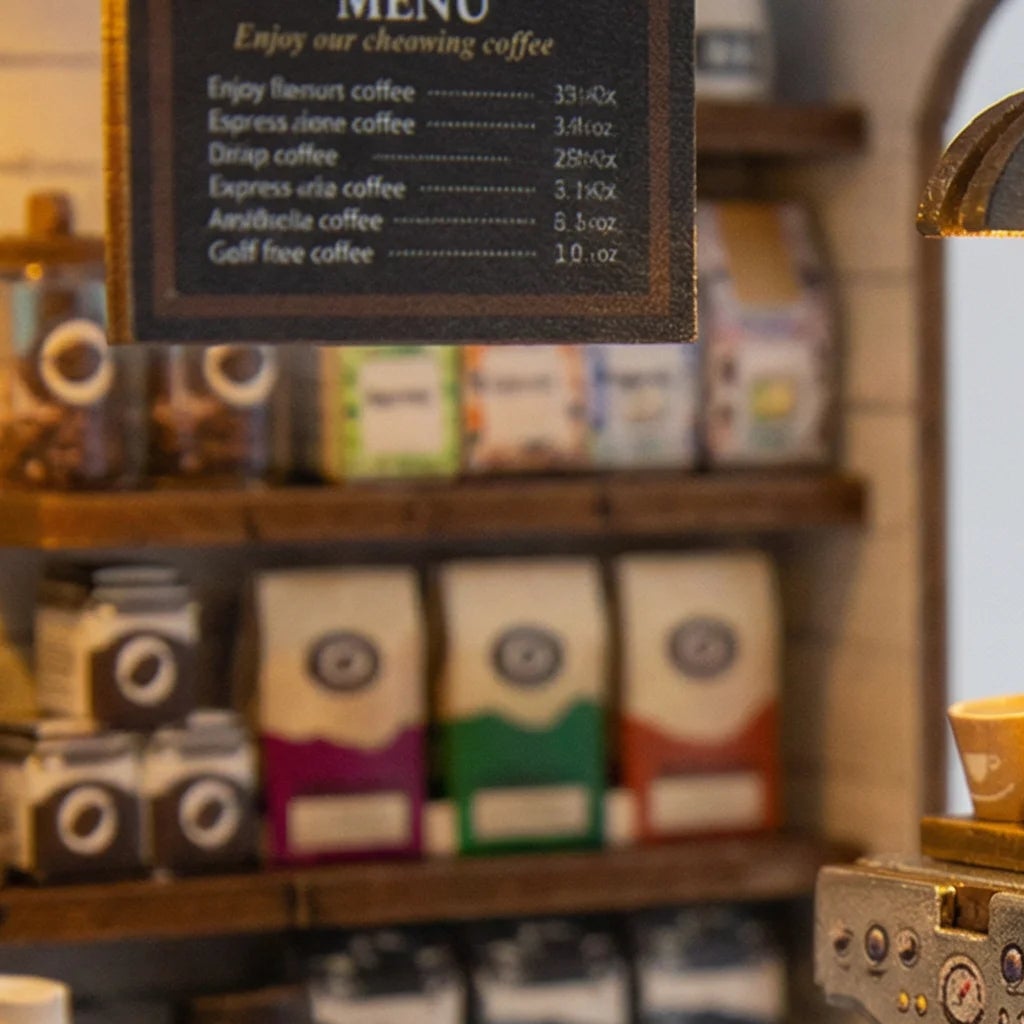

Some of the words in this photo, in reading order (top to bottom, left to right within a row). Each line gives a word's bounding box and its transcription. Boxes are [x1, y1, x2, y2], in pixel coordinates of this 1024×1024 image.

[336, 0, 491, 24] MENU
[233, 21, 308, 58] Enjoy
[312, 31, 358, 52] our
[481, 29, 555, 62] coffee
[207, 74, 266, 105] Enjoy
[351, 78, 416, 104] coffee
[351, 110, 416, 135] coffee
[273, 142, 341, 167] coffee
[342, 175, 407, 200] coffee
[318, 207, 385, 232] coffee
[310, 239, 376, 265] coffee
